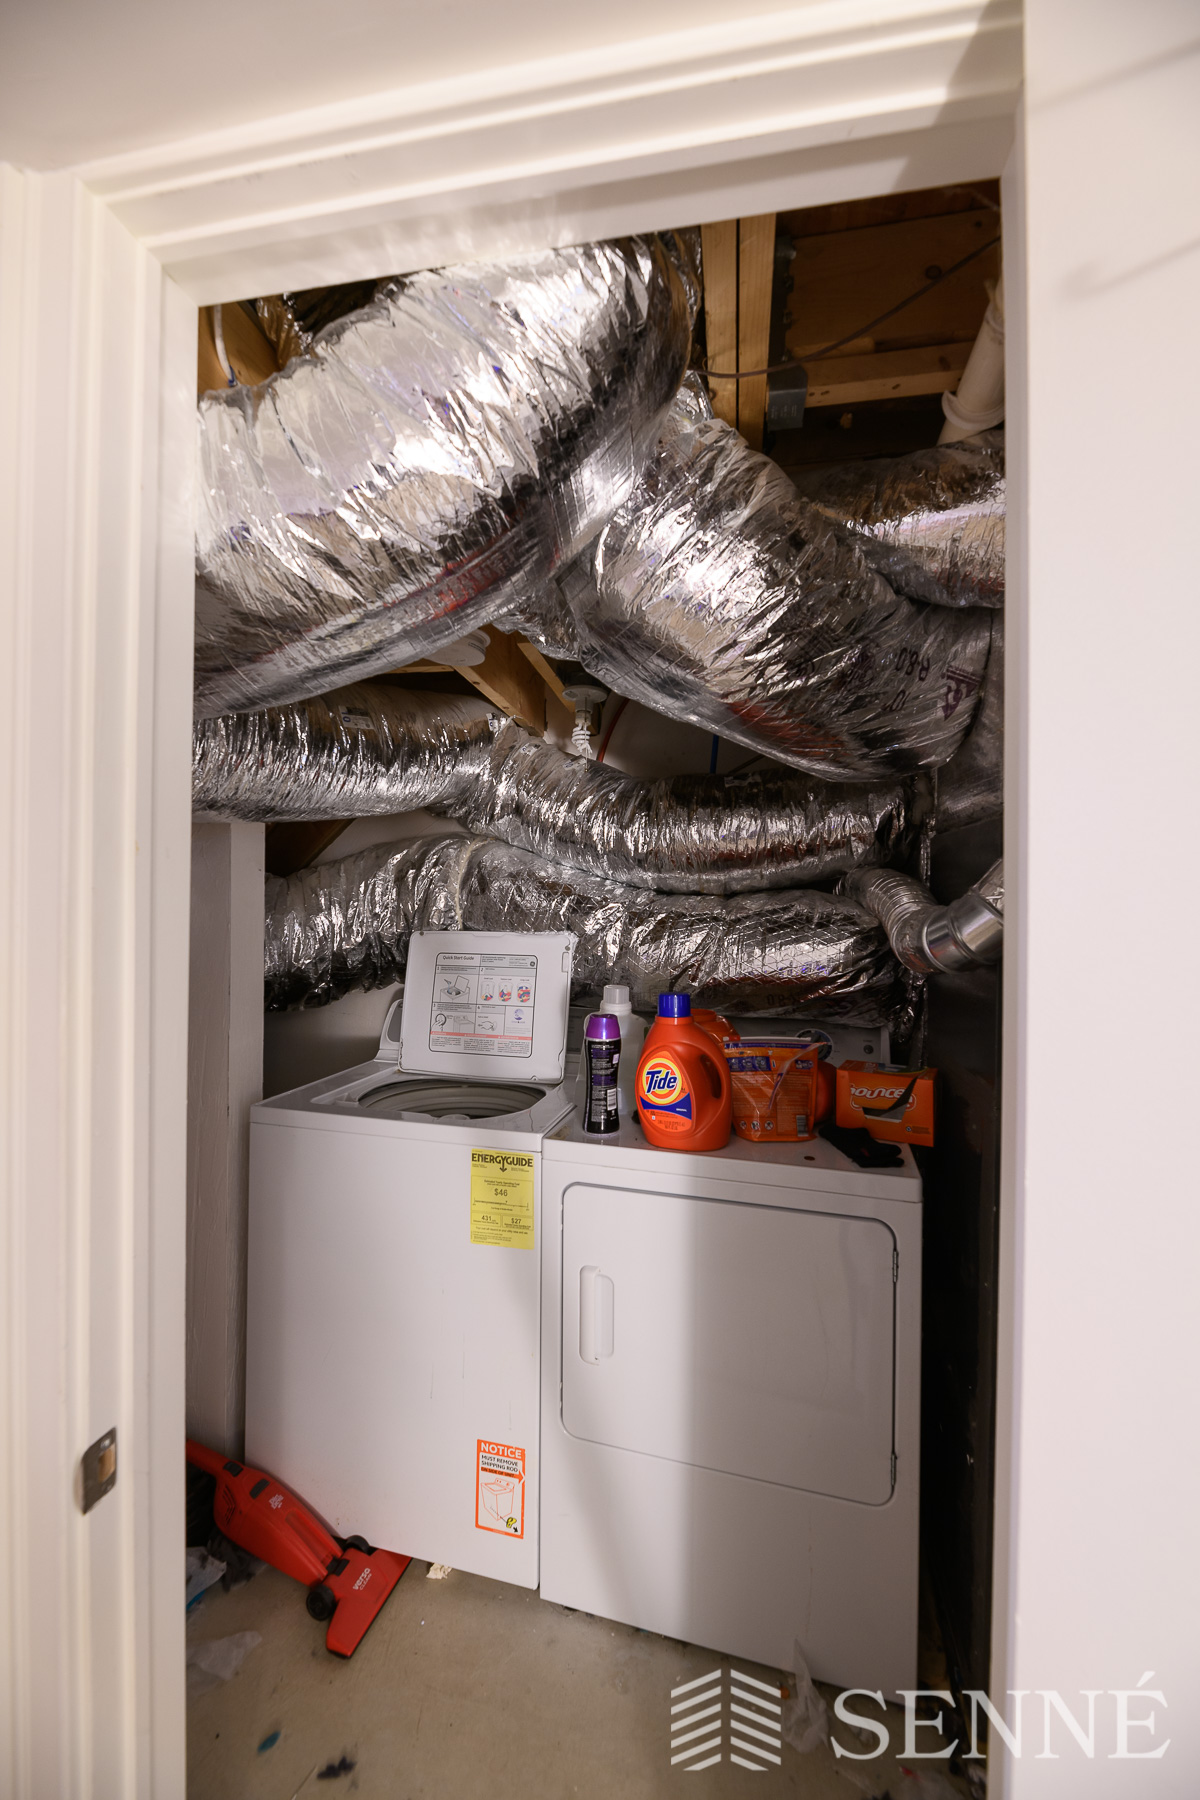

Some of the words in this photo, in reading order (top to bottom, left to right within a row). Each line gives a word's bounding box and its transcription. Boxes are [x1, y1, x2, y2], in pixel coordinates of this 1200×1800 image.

[645, 1069, 677, 1094] Tide
[494, 1188, 508, 1196] $46
[481, 1442, 522, 1459] NOTICE
[482, 1460, 506, 1470] SHIPPING
[496, 1458, 518, 1466] REMOVE
